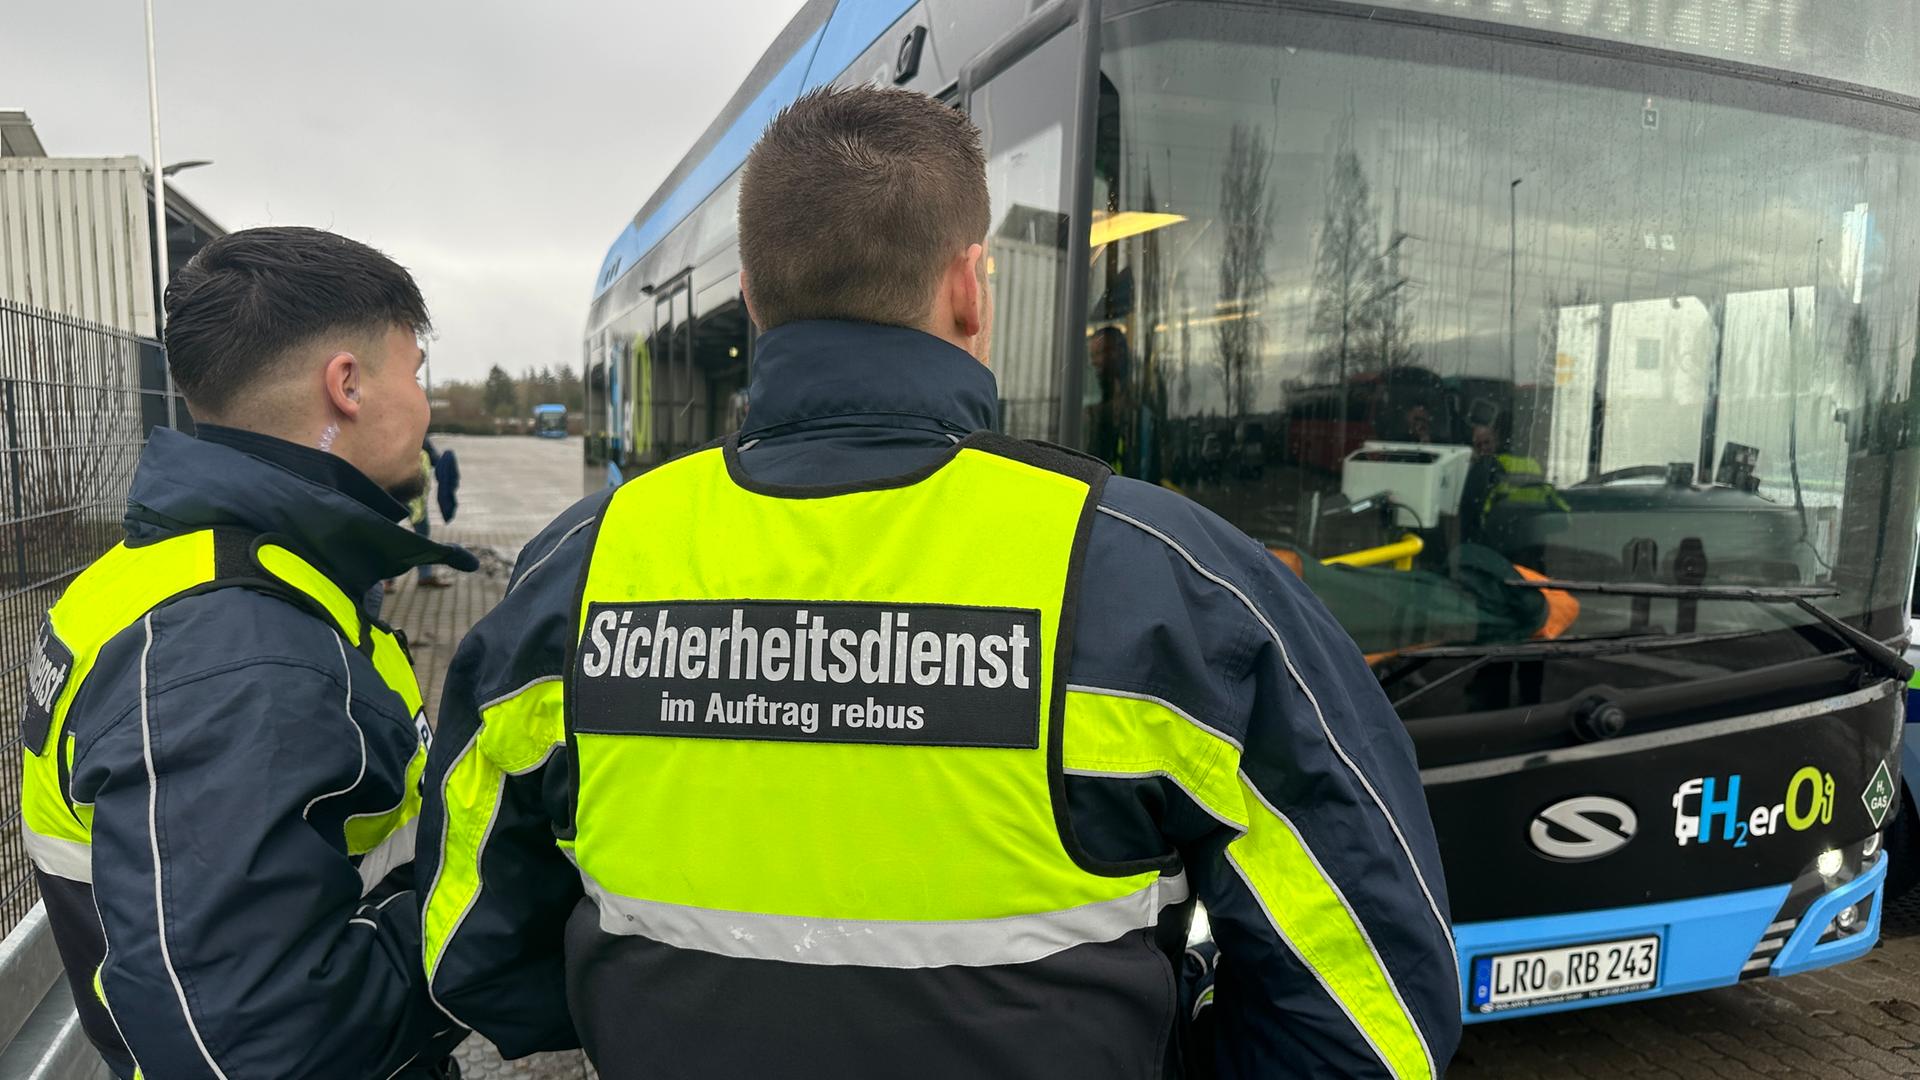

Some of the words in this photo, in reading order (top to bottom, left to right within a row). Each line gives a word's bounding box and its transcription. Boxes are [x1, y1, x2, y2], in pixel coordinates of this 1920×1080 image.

[583, 608, 1030, 689] Sicherheitsdienst
[660, 691, 695, 722] im
[705, 692, 819, 733] Auftrag
[831, 697, 925, 730] rebus
[1871, 795, 1888, 810] GAS
[1495, 958, 1546, 995] LRO
[1567, 952, 1599, 986] RB
[1606, 944, 1653, 980] 243
